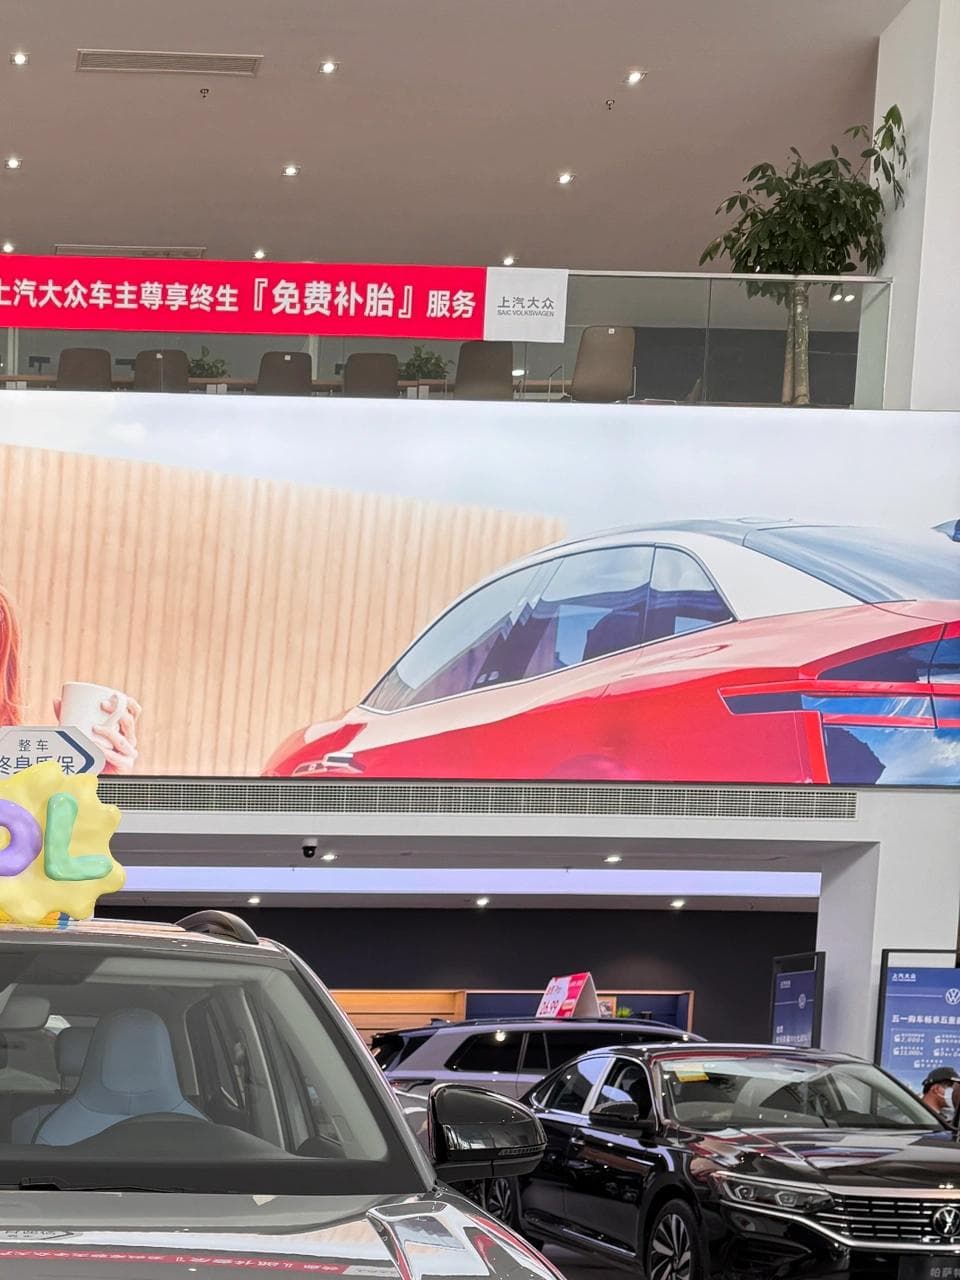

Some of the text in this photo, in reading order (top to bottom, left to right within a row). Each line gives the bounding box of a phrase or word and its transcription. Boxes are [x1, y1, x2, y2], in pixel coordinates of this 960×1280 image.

[497, 296, 555, 310] 上汽大众
[513, 310, 555, 318] VOLKSWAGEN
[18, 739, 49, 752] 整车
